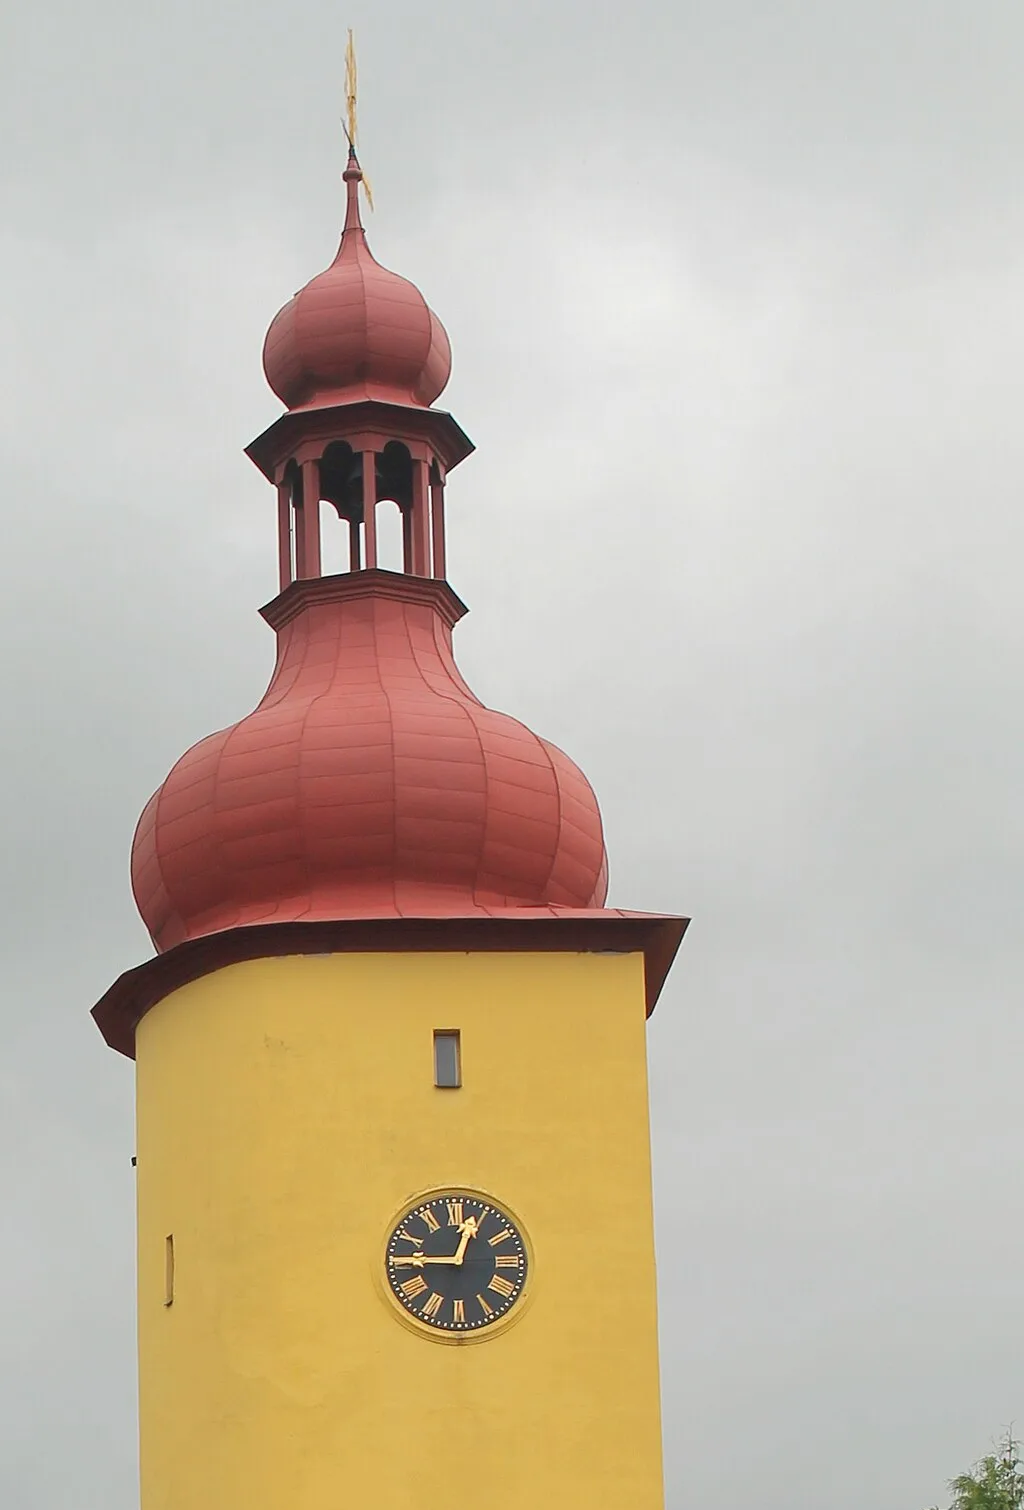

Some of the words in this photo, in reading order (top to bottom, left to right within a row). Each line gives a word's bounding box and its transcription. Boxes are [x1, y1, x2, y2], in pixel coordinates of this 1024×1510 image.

[419, 1209, 441, 1234] XI
[446, 1203, 464, 1226] XII
[399, 1229, 424, 1249] X
[487, 1229, 512, 1247] II
[495, 1255, 520, 1268] III
[399, 1275, 429, 1301] VIII
[487, 1274, 516, 1298] IIII
[421, 1292, 445, 1317] VII
[453, 1300, 466, 1323] VI
[476, 1294, 494, 1315] V
